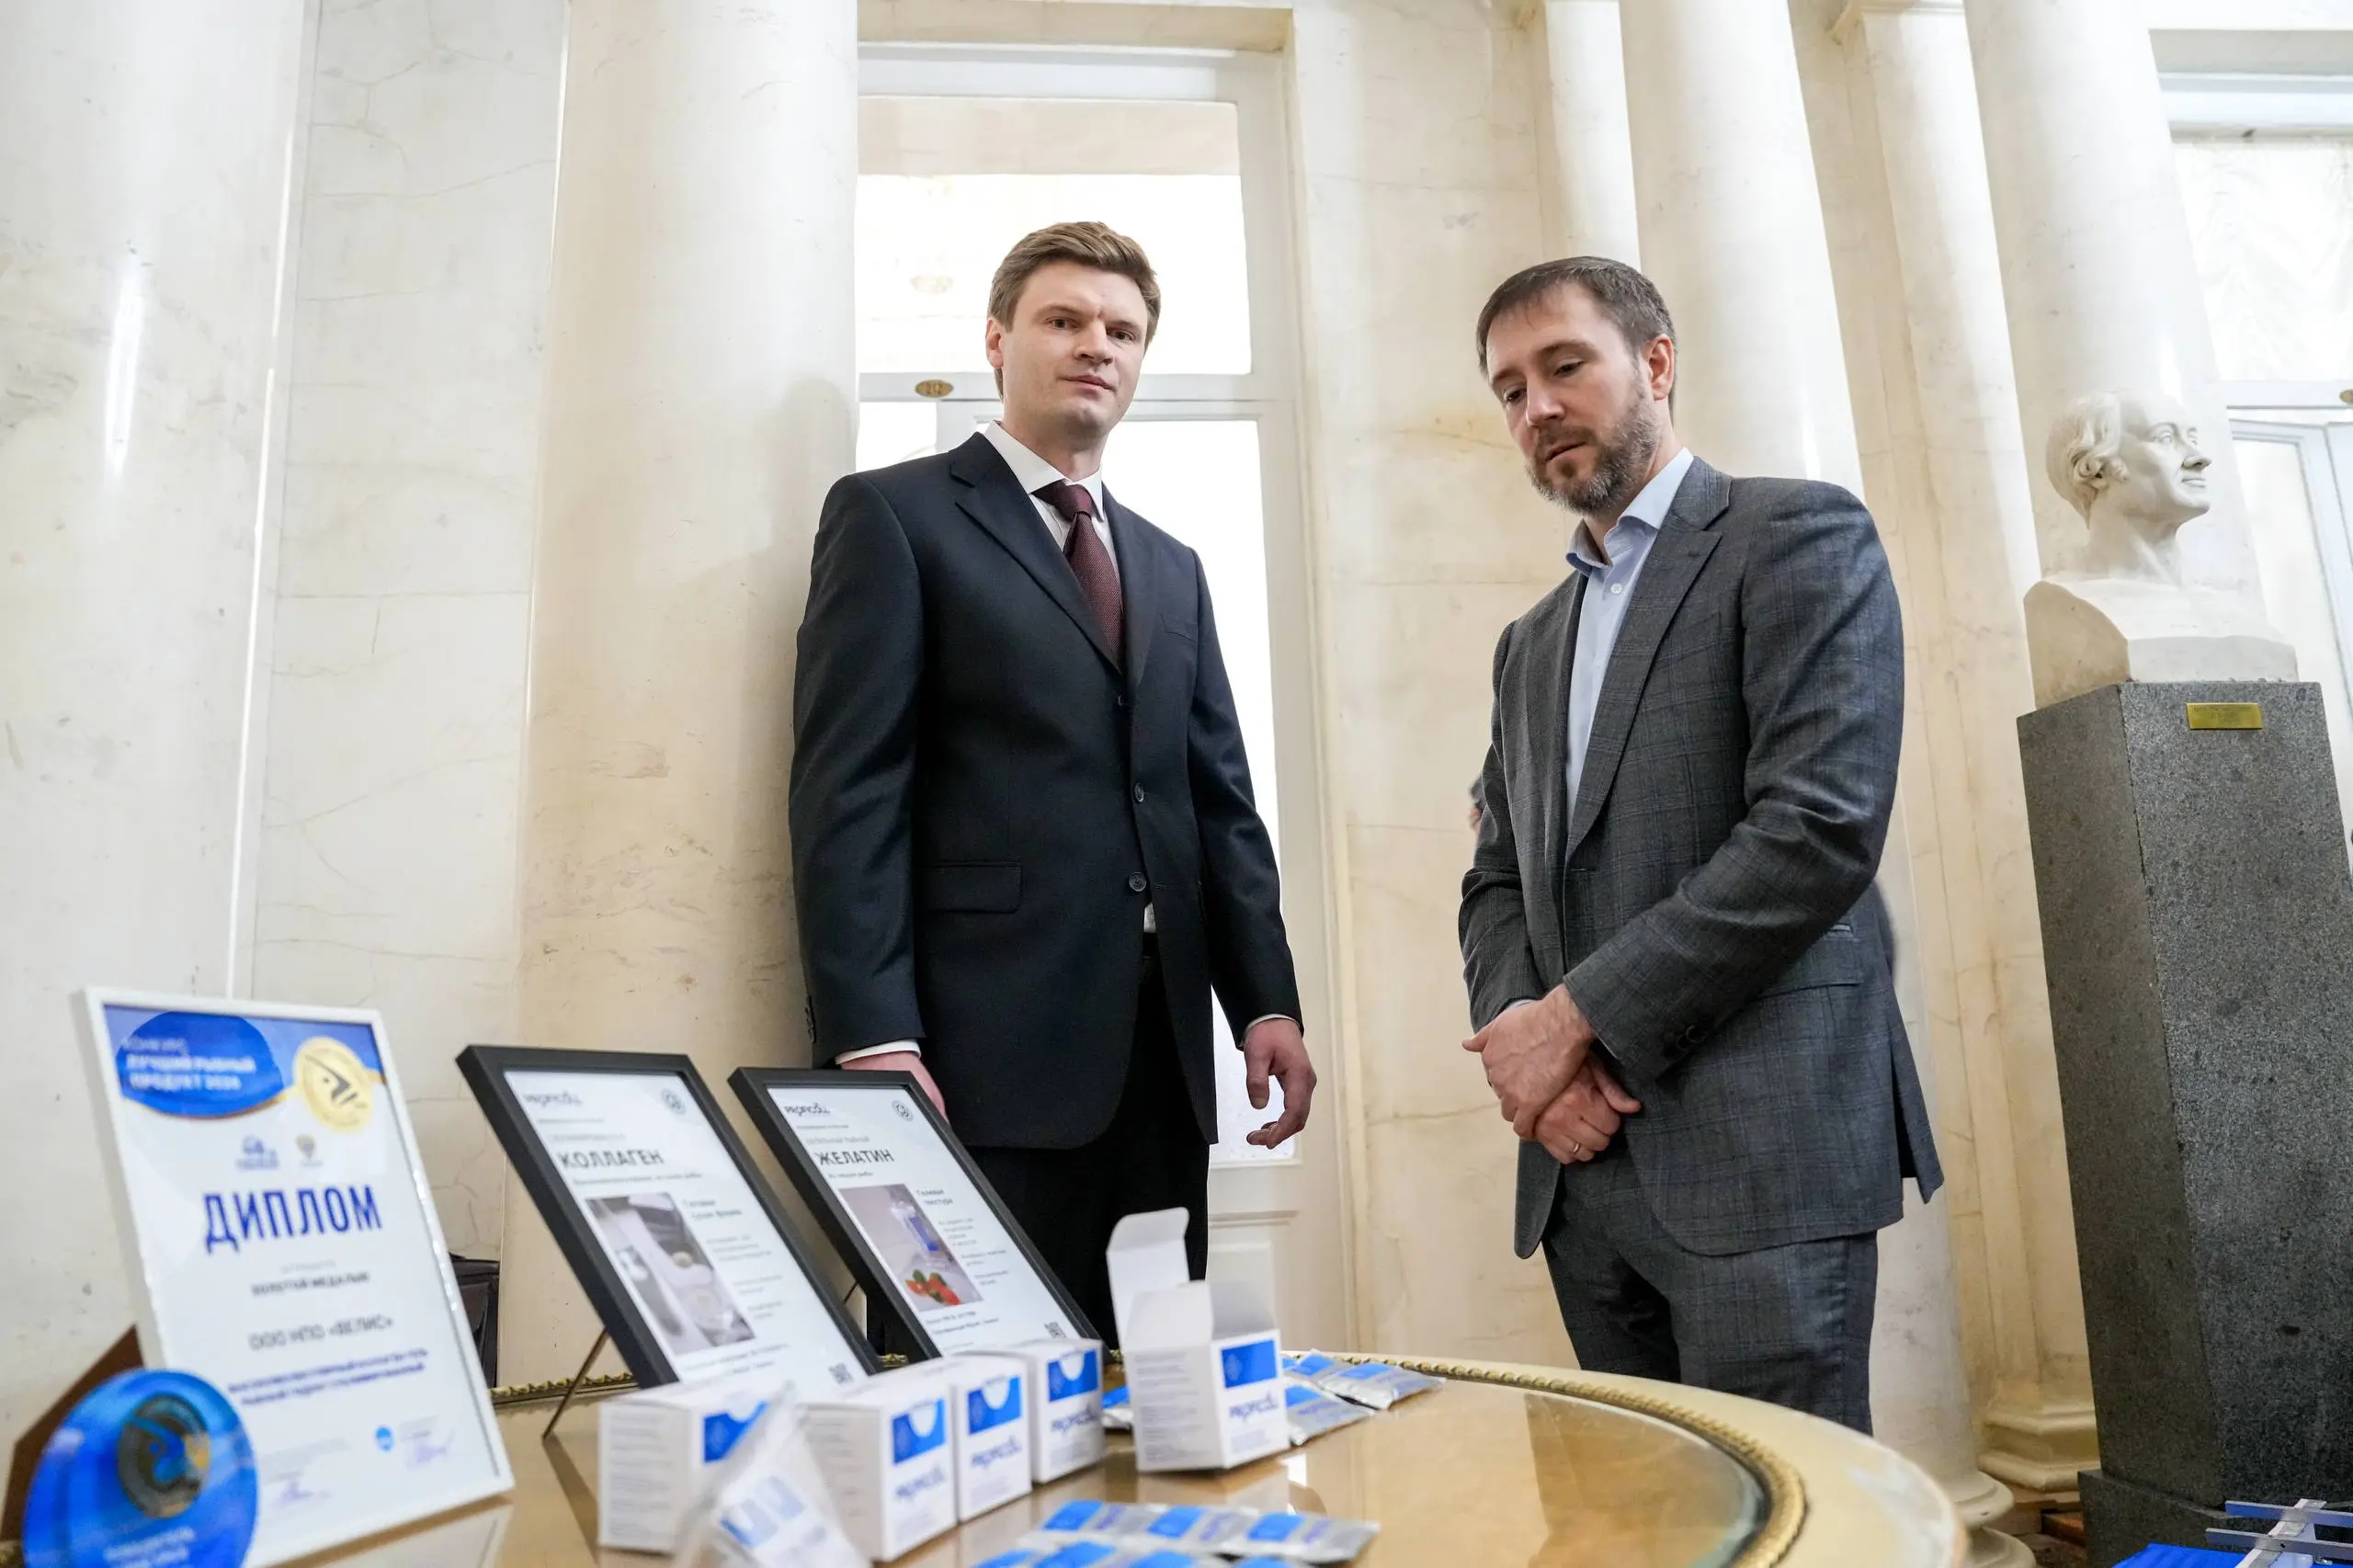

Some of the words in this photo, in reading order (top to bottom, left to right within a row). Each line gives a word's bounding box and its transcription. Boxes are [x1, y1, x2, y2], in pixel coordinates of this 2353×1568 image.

[557, 1149, 665, 1170] КОЛЛАГЕН
[814, 1149, 895, 1166] ЖЕЛАТИН
[204, 1184, 382, 1255] ДИПЛОМ
